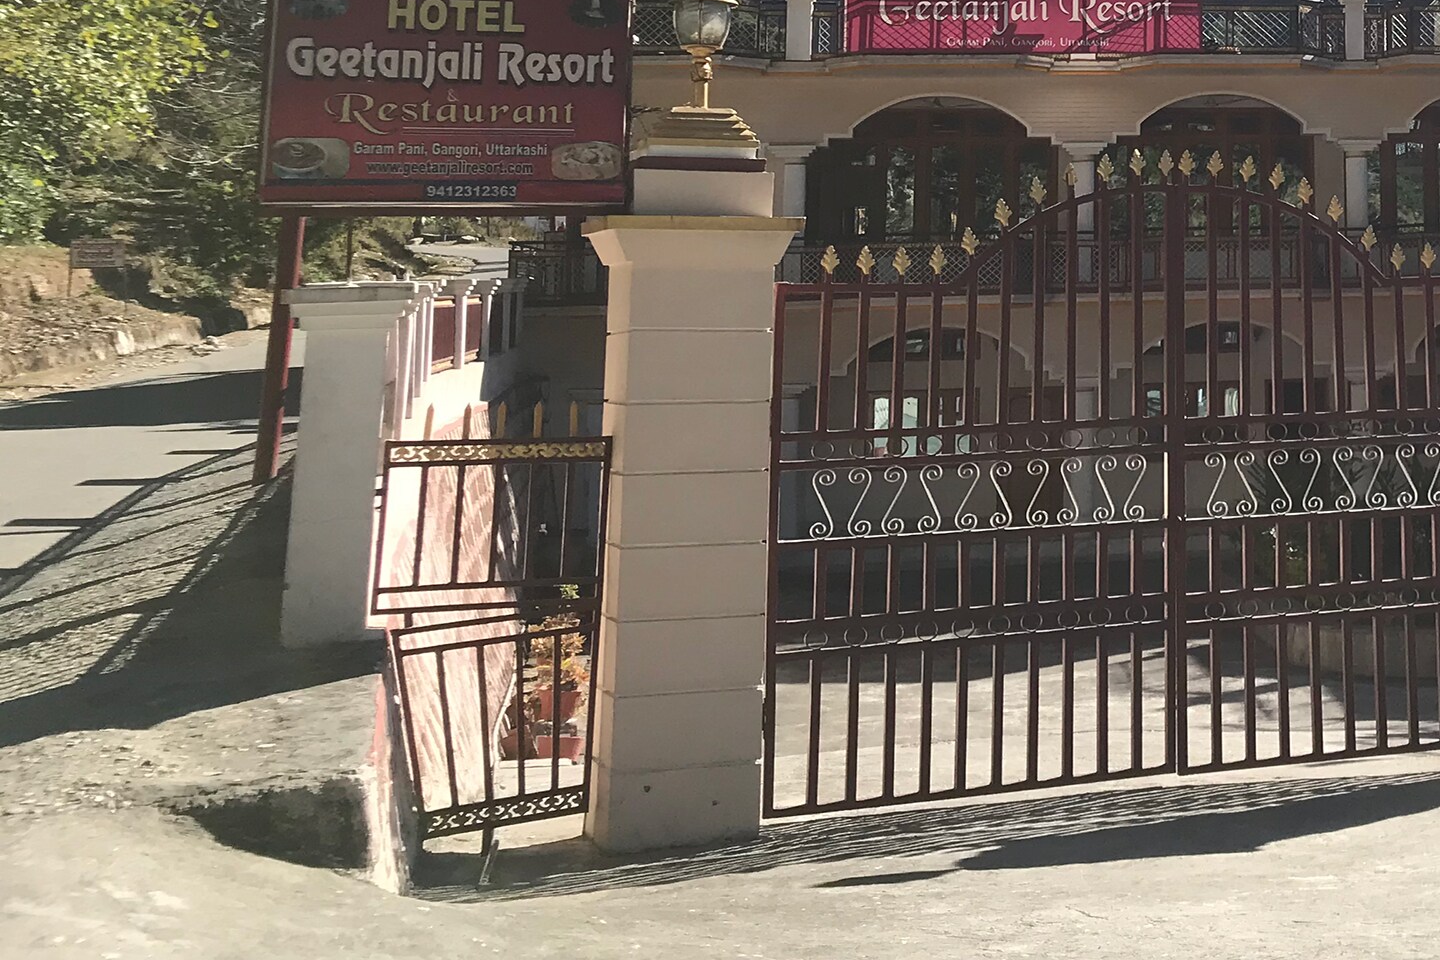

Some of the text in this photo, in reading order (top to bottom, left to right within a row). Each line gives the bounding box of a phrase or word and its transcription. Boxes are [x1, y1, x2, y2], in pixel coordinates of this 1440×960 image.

[286, 37, 615, 89] Geetanjali Resort
[446, 88, 459, 102] &
[324, 92, 574, 135] Restaurant
[353, 141, 548, 158] Garam Pani, Gangori, Uttarkashi
[366, 159, 534, 177] www.geetanjaliresort.com
[426, 185, 518, 198] 9412312363
